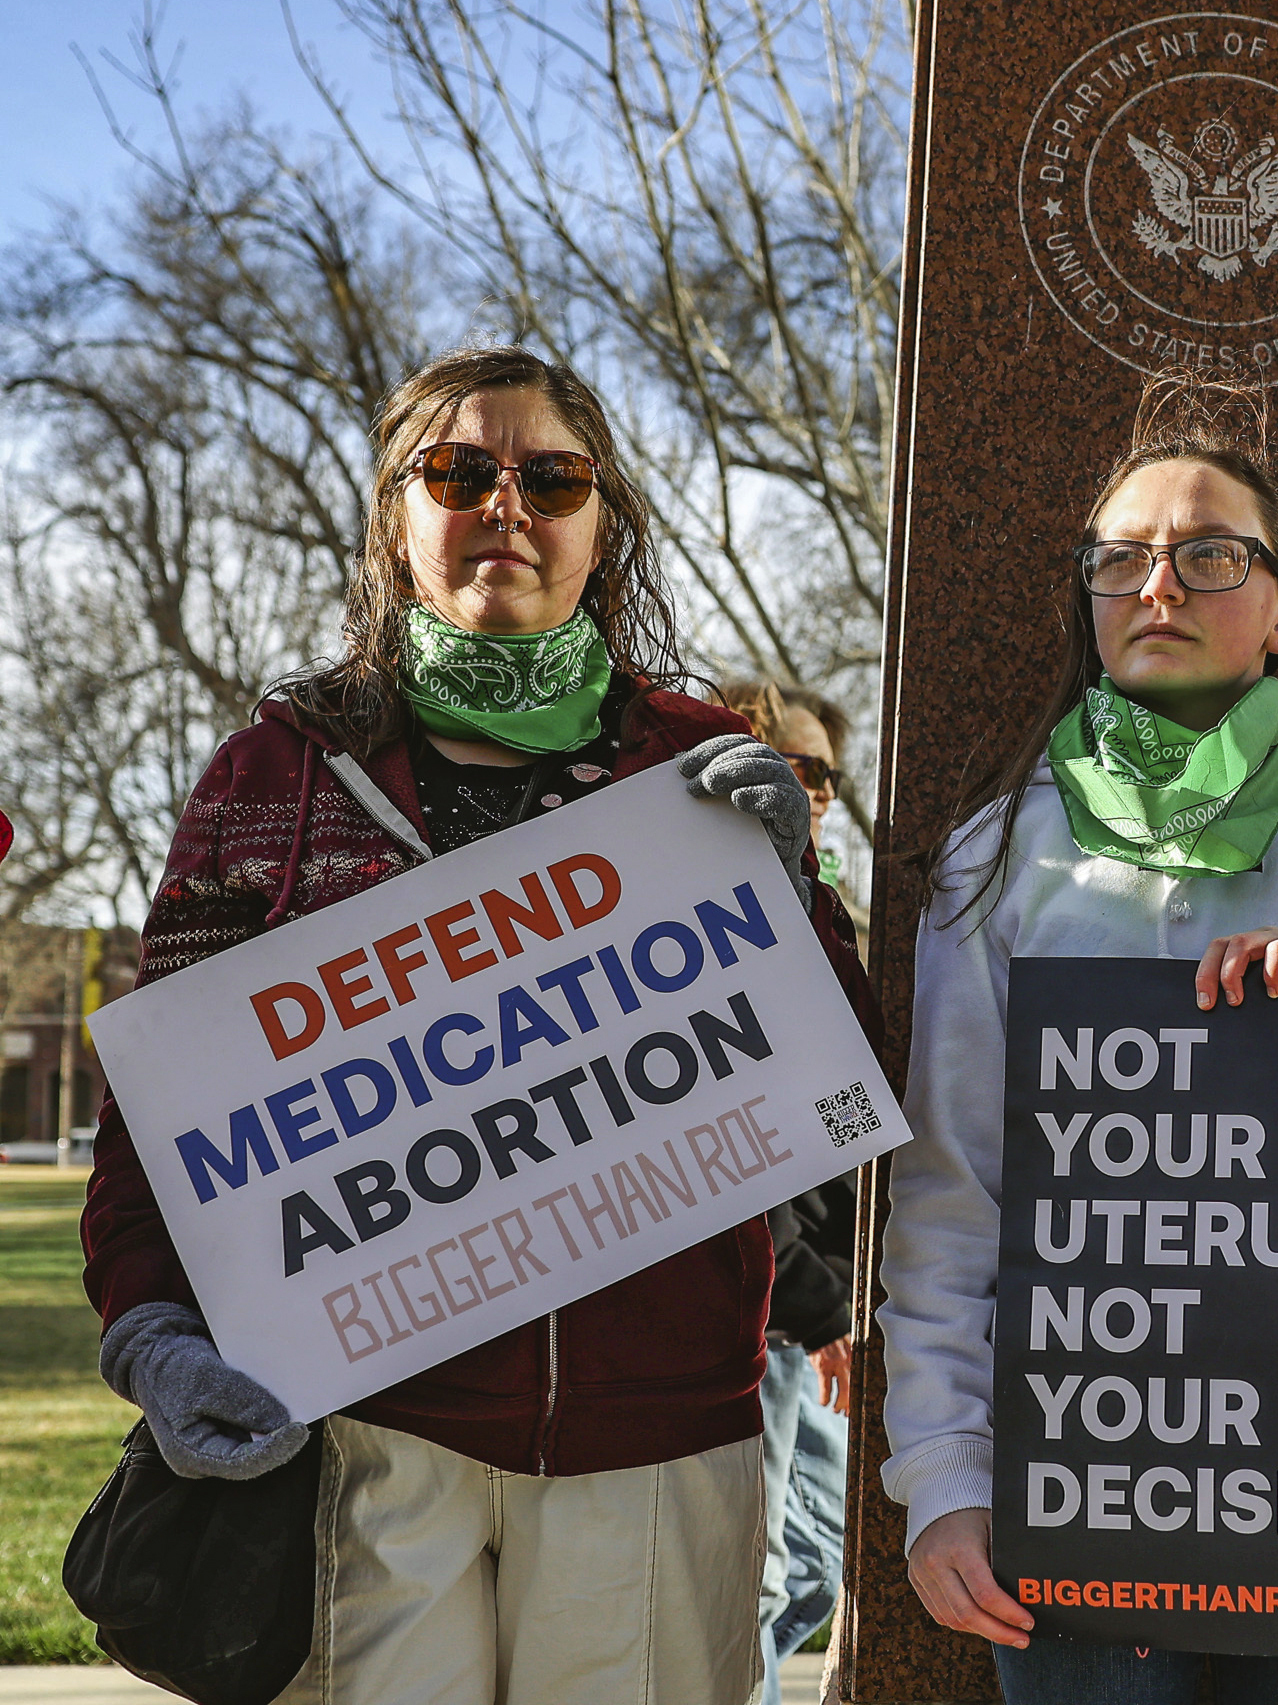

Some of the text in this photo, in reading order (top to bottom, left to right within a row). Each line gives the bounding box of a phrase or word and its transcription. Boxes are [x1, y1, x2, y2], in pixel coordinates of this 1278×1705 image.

[1040, 32, 1199, 182] DEPARTMENT
[1224, 32, 1267, 58] OF
[1046, 231, 1120, 325] UNITED
[1128, 324, 1235, 370] STATES
[249, 853, 622, 1061] DEFEND
[174, 881, 778, 1204] MEDICATION
[1039, 1027, 1209, 1091] NOT
[282, 991, 774, 1278] ABORTION
[1034, 1112, 1267, 1179] YOUR
[322, 1094, 794, 1365] BIGGER THAN ROE
[1029, 1285, 1201, 1355] NOT
[1024, 1373, 1262, 1446] YOUR
